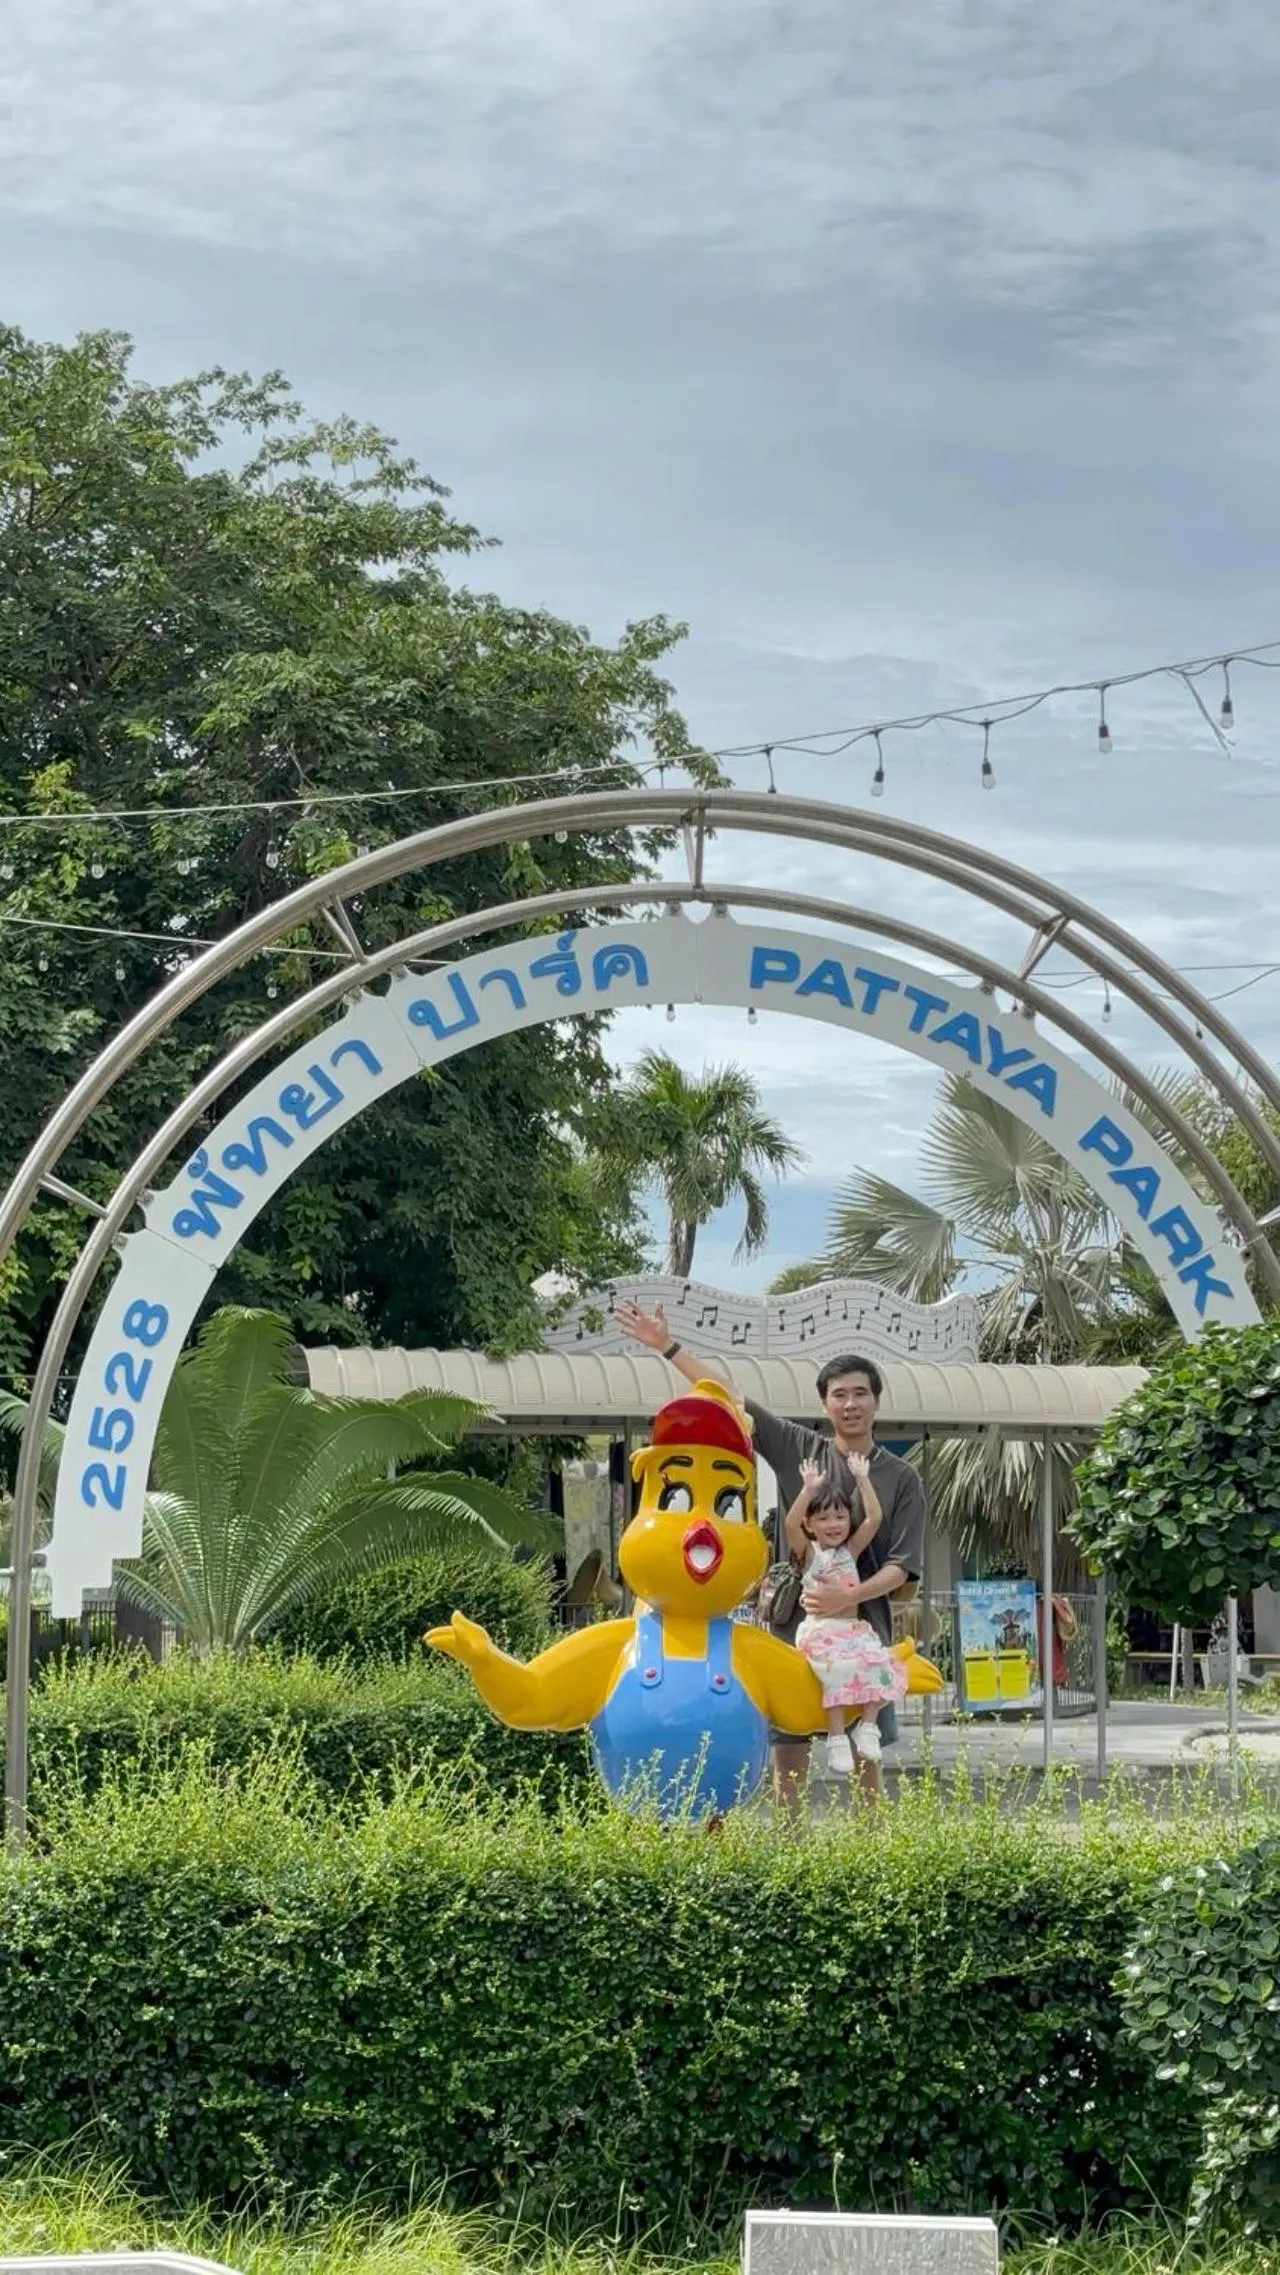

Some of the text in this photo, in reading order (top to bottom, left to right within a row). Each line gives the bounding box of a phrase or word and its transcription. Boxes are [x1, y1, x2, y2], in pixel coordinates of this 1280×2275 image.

[82, 930, 650, 1509] 2528 พัทยา ปาร์ค
[749, 946, 1234, 1315] PATTAYA PARK
